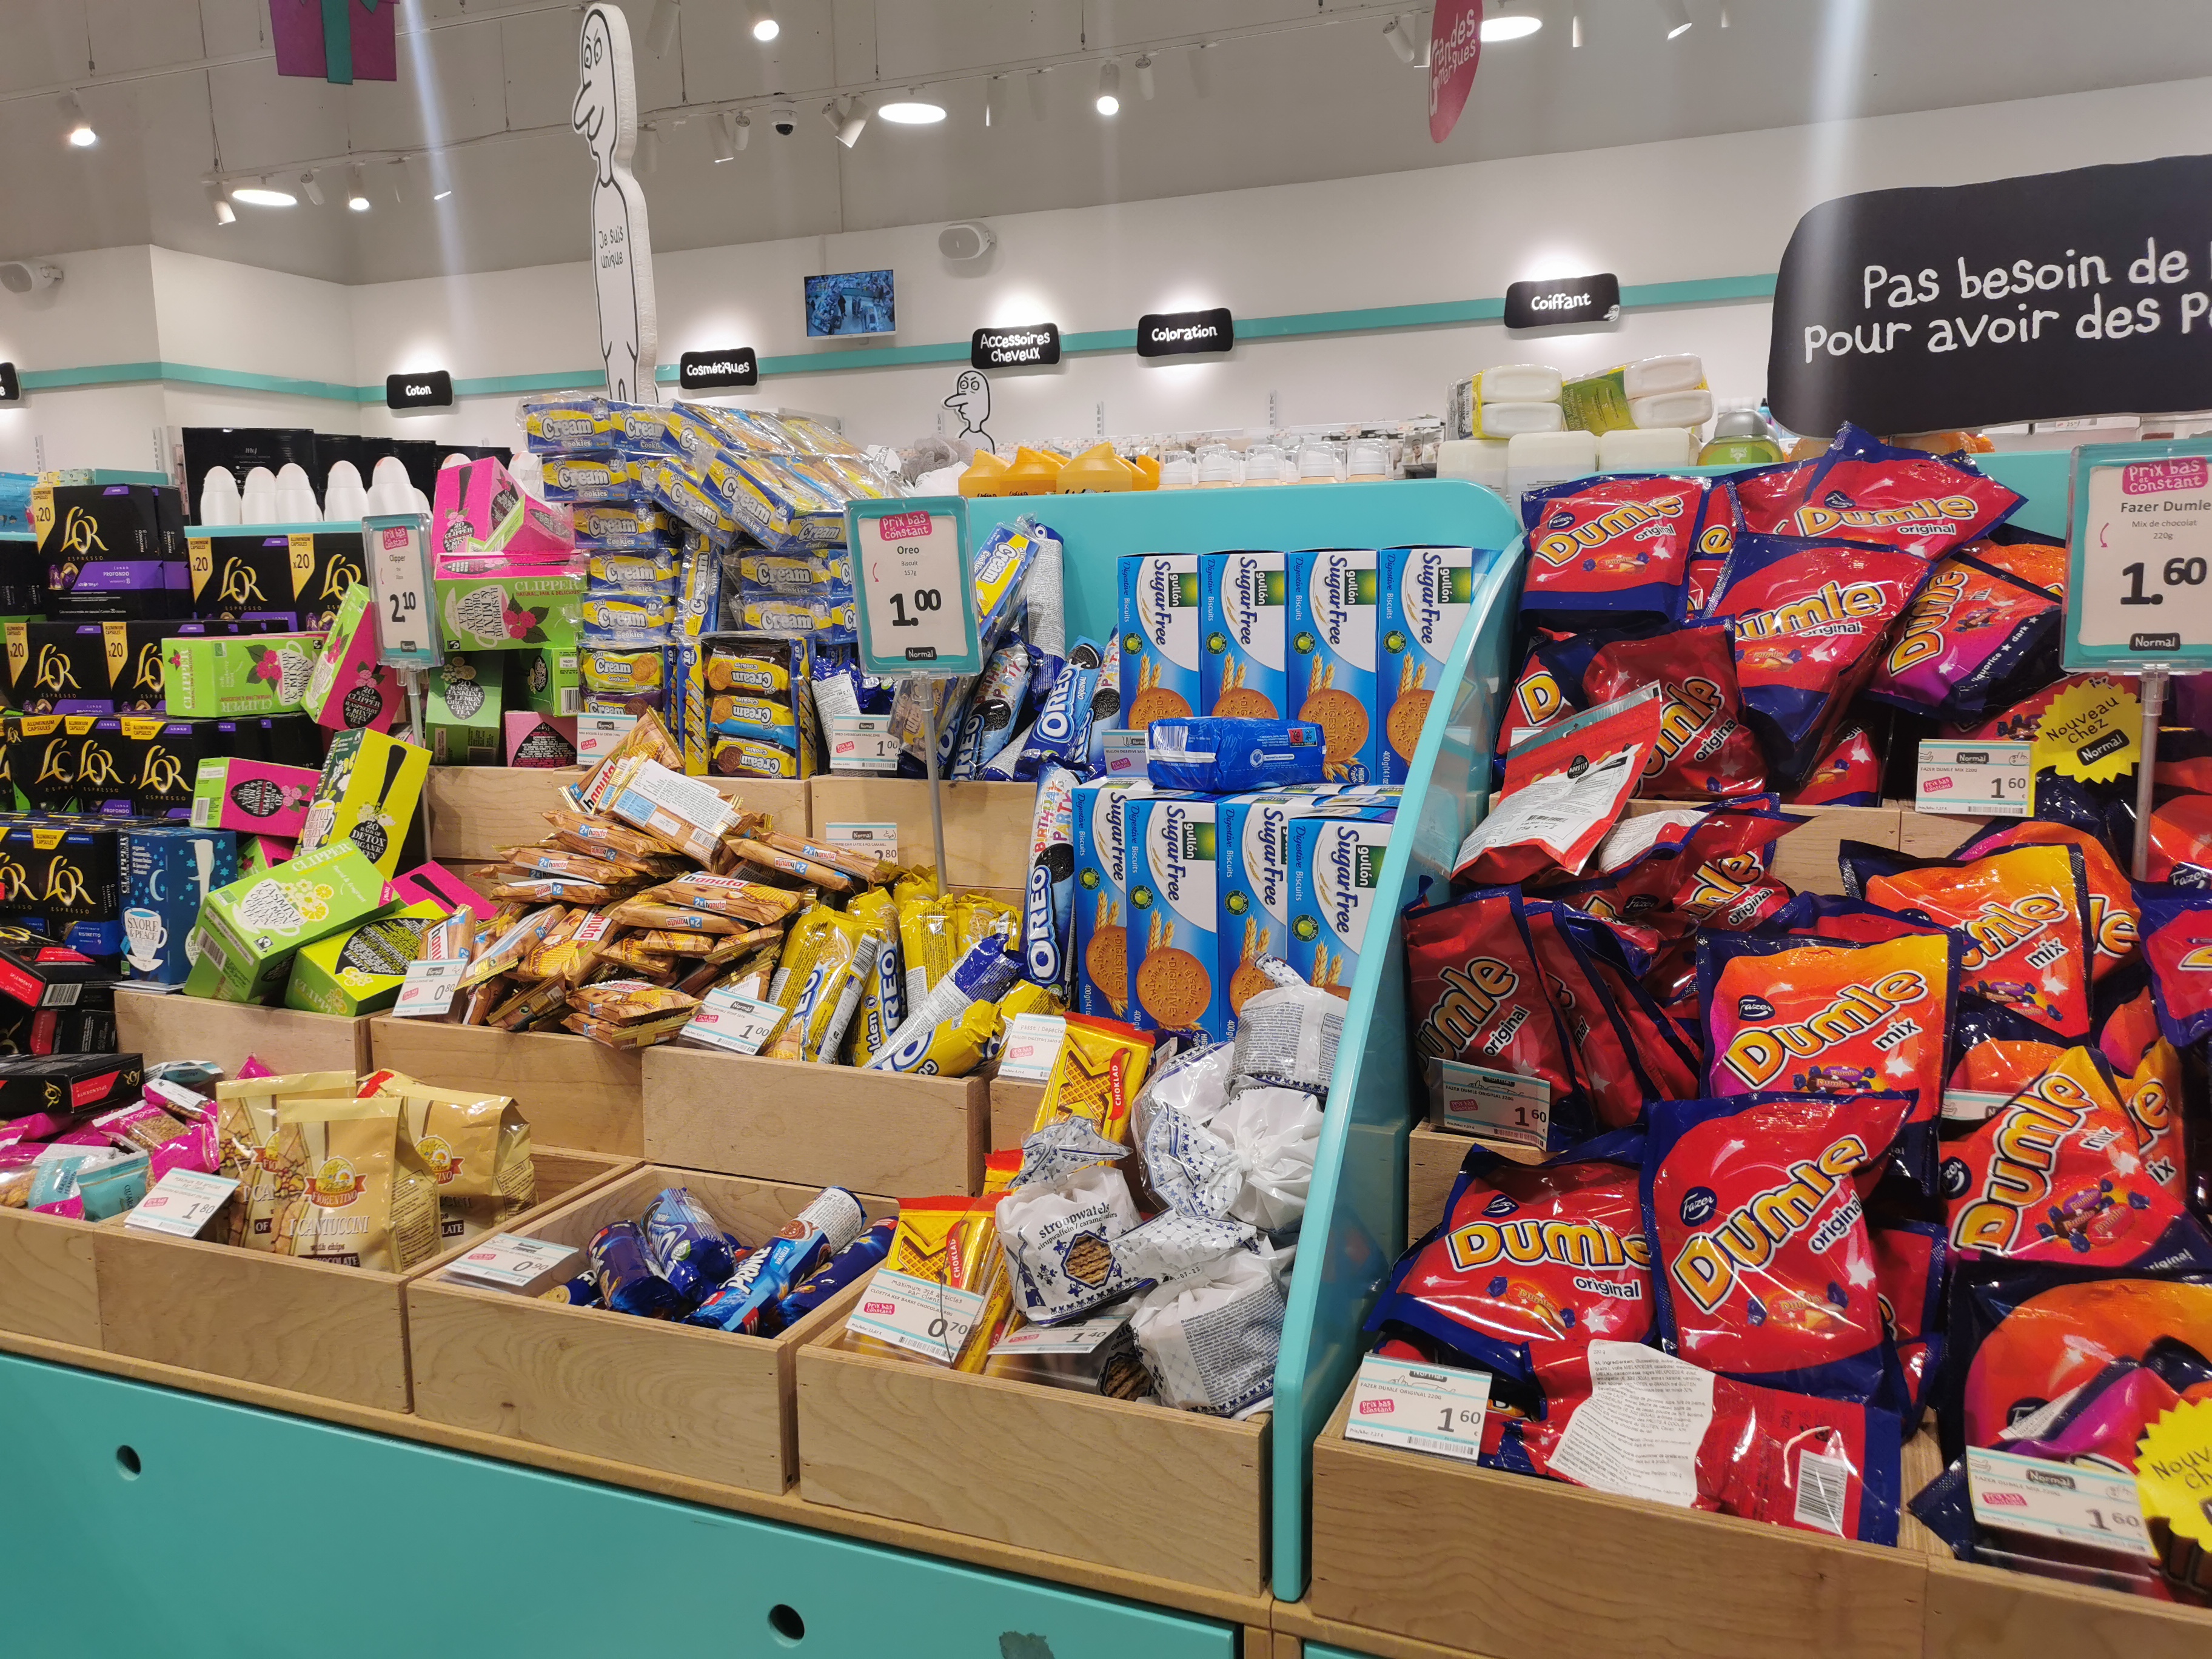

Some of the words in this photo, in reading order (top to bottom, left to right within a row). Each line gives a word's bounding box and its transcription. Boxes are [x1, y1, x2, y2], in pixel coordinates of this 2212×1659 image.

[609, 225, 623, 244] suis
[600, 250, 623, 269] unique
[1865, 265, 1940, 308] Pas
[1959, 249, 2111, 299] besoin
[2128, 236, 2189, 284] de
[1531, 291, 1592, 312] Coiffant
[980, 332, 1051, 349] Accessoires
[1151, 324, 1218, 343] Coloration
[1805, 323, 1912, 364] pour
[1928, 303, 2059, 352] avoir
[2076, 293, 2161, 339] des
[686, 361, 750, 377] Cosmétiques
[406, 384, 432, 397] Coton
[542, 418, 595, 440] Cream
[558, 469, 610, 490] Cream
[2169, 459, 2201, 475] bas
[36, 507, 51, 522] x20
[1795, 493, 1979, 539] Dumle
[2120, 501, 2159, 513] Fazer
[2163, 499, 2211, 512] Dumle
[589, 515, 638, 536] Cream
[908, 514, 927, 526] bas
[1537, 494, 1686, 568] Dumle
[1548, 514, 1575, 528] Fazer
[1635, 524, 1675, 541] original
[1897, 522, 1957, 537] original
[193, 556, 209, 571] x20
[293, 554, 310, 569] x20
[389, 554, 406, 563] Clipper
[606, 563, 655, 583] Cream
[1122, 561, 1131, 595] Digestive
[1150, 559, 1171, 611] Sugar
[1206, 558, 1215, 594] Digestive
[1235, 557, 1258, 609] Sugar
[1294, 557, 1304, 592] Digestive
[1325, 555, 1347, 609] Sugar
[1387, 554, 1396, 591] Digestive
[1440, 568, 1453, 603] gullón
[515, 580, 578, 593] CLIPPER
[1170, 574, 1181, 606] gullón
[1256, 572, 1268, 605] gullón
[1346, 571, 1358, 605] gullón
[472, 593, 484, 635] ORGANIC
[481, 602, 495, 637] MINT
[490, 587, 503, 638] RASPBERRY
[598, 609, 647, 629] Cream
[1887, 569, 1969, 678] Dumle
[1156, 611, 1172, 645] Free
[1241, 611, 1258, 645] Free
[1329, 609, 1347, 645] Free
[2011, 625, 2029, 643] dark
[10, 643, 24, 657] x20
[908, 649, 934, 659] Normal
[2135, 636, 2175, 648] Normal
[180, 649, 192, 709] CLIPPER
[1078, 676, 1087, 700] ORIGINAL
[1041, 669, 1076, 739] OREO
[2045, 697, 2120, 742] Nouveau
[1959, 754, 1986, 762] Normal
[2080, 734, 2124, 762] Normal
[367, 822, 378, 831] 20
[1053, 793, 1073, 842] PARTY
[351, 829, 387, 847] DETOX
[292, 842, 354, 872] CLIPPER
[682, 875, 745, 887] hanuta
[261, 882, 304, 927] JASMINE
[695, 897, 705, 908] 2x
[706, 900, 726, 910] hanuta
[127, 917, 159, 933] SNORE
[1028, 866, 1055, 982] OREO
[2025, 937, 2070, 970] mix
[1721, 970, 1928, 1090] Dumle
[1872, 1019, 1923, 1051] mix
[1112, 1065, 1121, 1106] CHOKLAD
[1478, 1091, 1501, 1099] ORIGINAL
[1952, 1072, 2098, 1255] Dumle
[312, 1190, 357, 1205] FIORENTINO
[297, 1216, 370, 1237] CANTUCCINI
[1037, 1225, 1074, 1250] sirupwaffeln
[1080, 1216, 1103, 1229] caramel
[1039, 1202, 1110, 1239] stroopwafels
[1671, 1134, 1869, 1315] Dumle
[719, 1246, 773, 1295] PRINCE
[950, 1238, 960, 1279] CHOKLAD
[871, 1289, 890, 1297] CLOETTA
[1573, 1276, 1641, 1300] original
[1399, 1389, 1426, 1398] ORIGINAL
